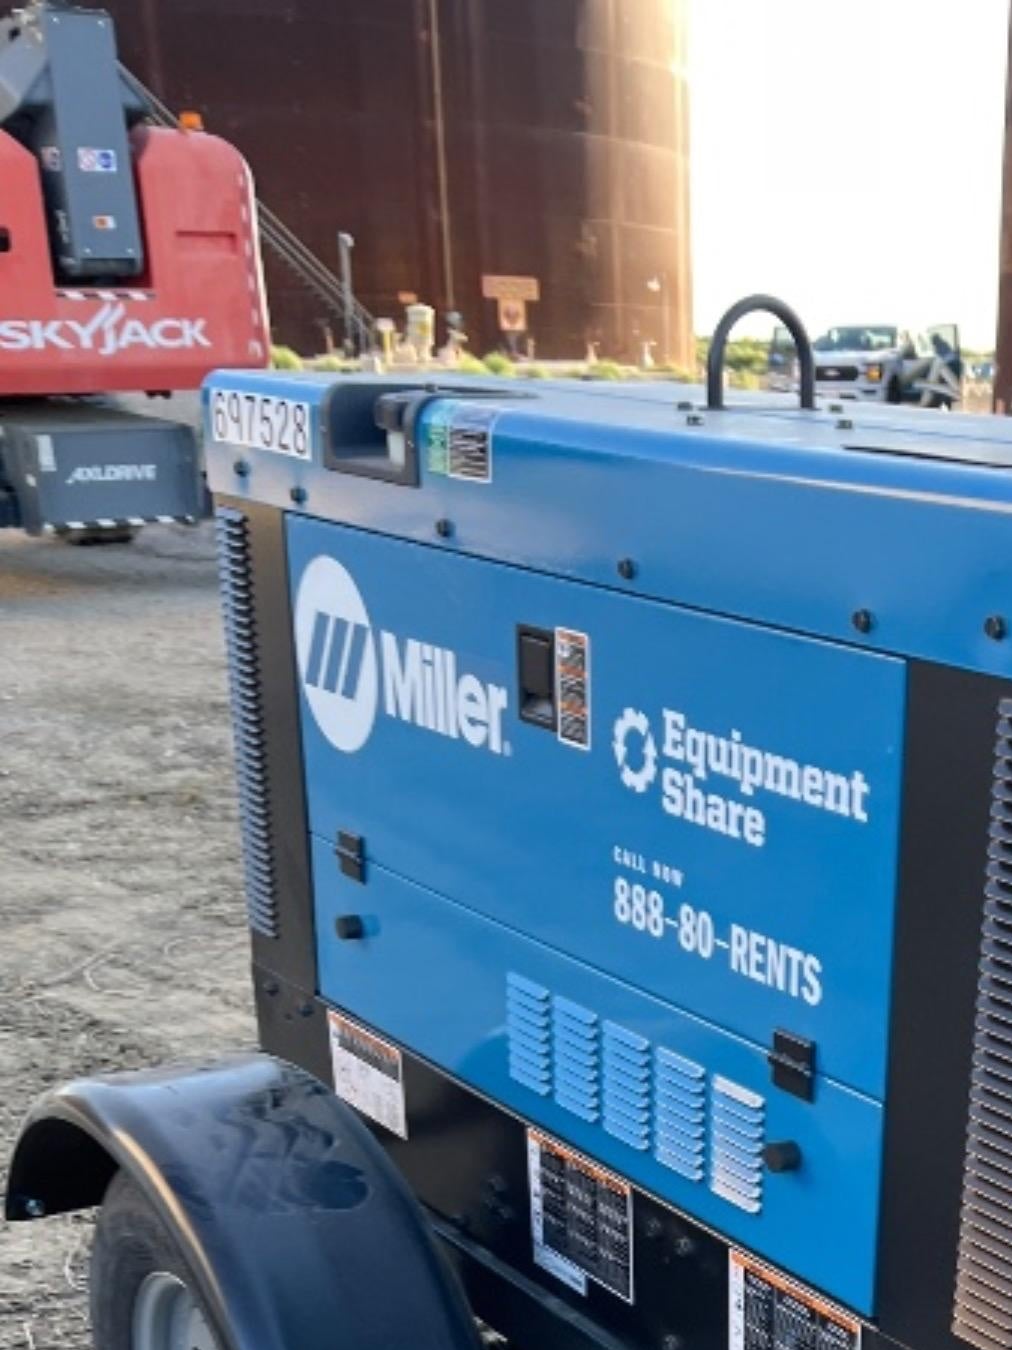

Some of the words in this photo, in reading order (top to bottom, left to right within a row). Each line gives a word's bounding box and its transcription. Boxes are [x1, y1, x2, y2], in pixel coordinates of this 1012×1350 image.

[0, 302, 213, 355] SKYJACK
[214, 391, 307, 454] 697528
[380, 628, 509, 756] Miller
[662, 707, 871, 823] Equipment
[661, 766, 766, 847] Share
[613, 845, 646, 874] CALL
[613, 876, 823, 1006] 888-80-RENTS
